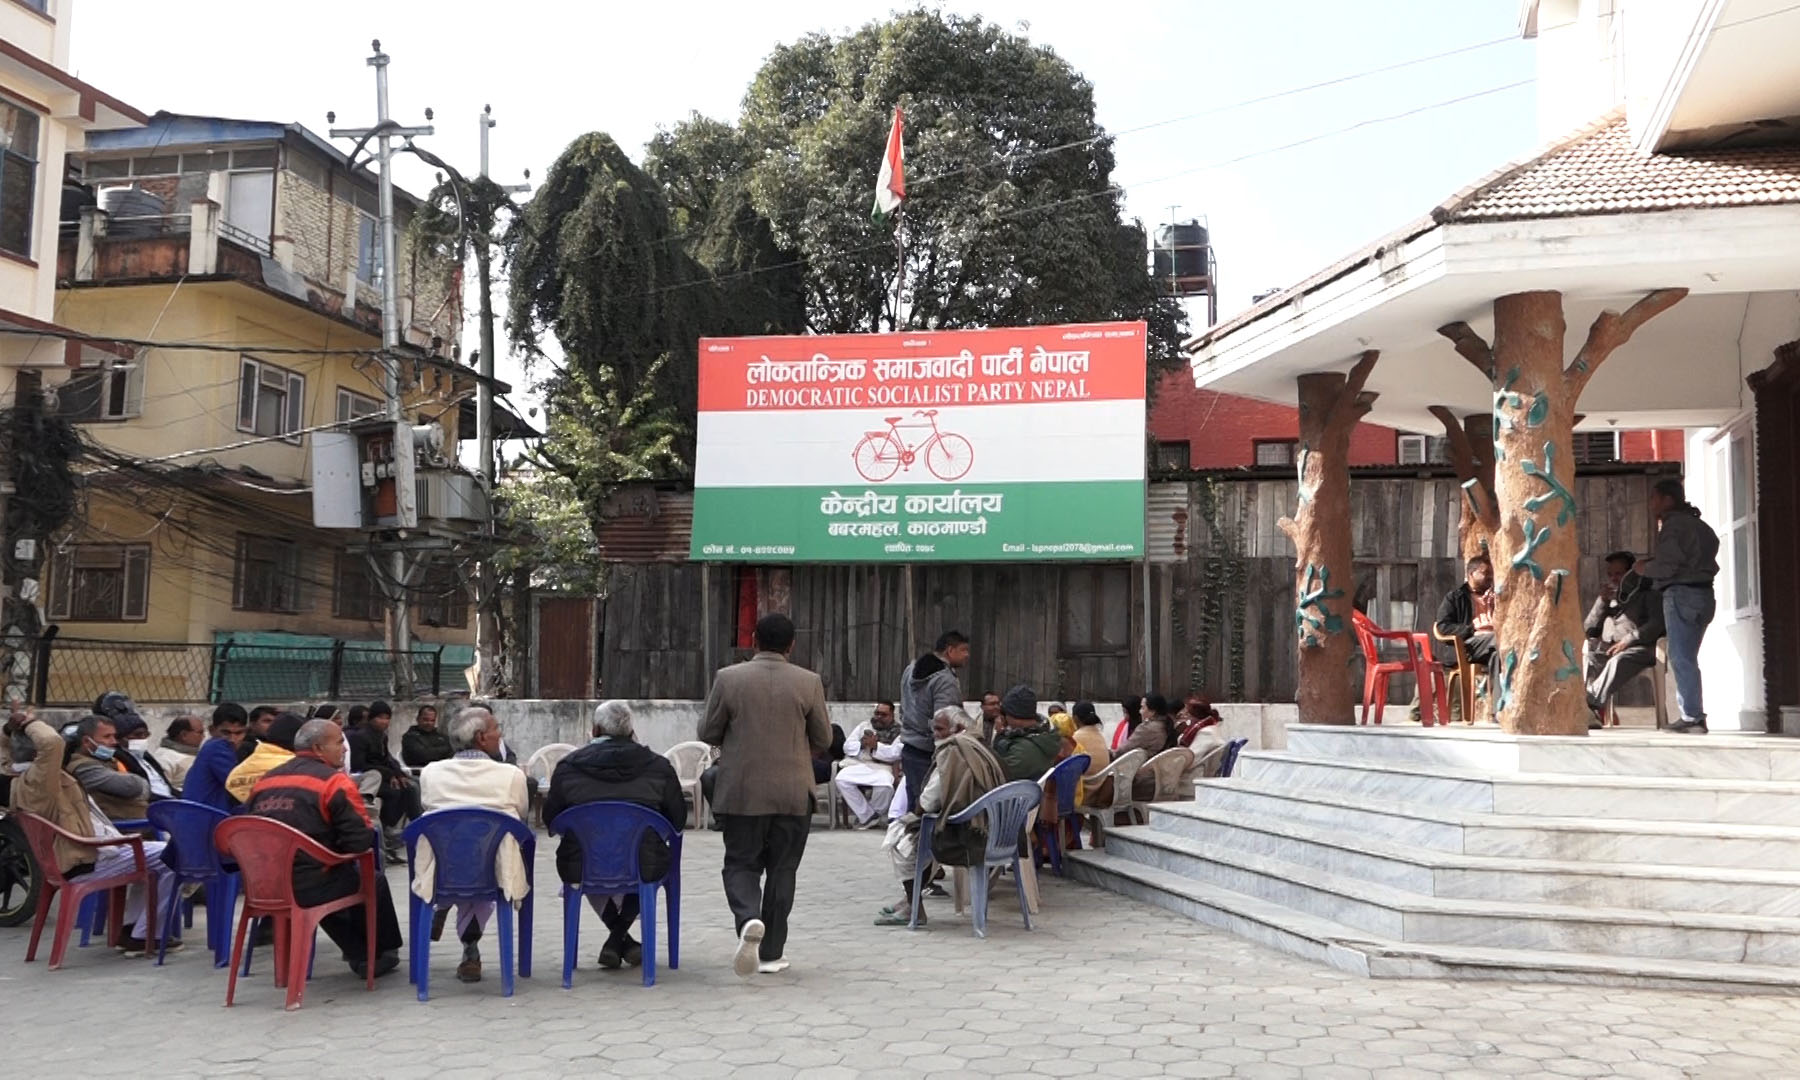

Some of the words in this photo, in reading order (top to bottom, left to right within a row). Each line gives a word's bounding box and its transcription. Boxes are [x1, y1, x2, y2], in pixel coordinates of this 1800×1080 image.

[747, 353, 867, 384] लोकतान्त्रिक
[873, 349, 974, 381] समाजवादी
[981, 347, 1024, 376] पार्टी
[1030, 345, 1090, 374] नेपाल
[747, 387, 863, 407] DEMOCRATIC
[868, 383, 963, 405] SOCIALIST
[968, 381, 1025, 402] PARTY
[1031, 379, 1090, 399] NEPAL
[820, 491, 898, 517] केन्द्रीय
[905, 490, 1003, 514] कार्यालय
[1003, 543, 1025, 553] Email
